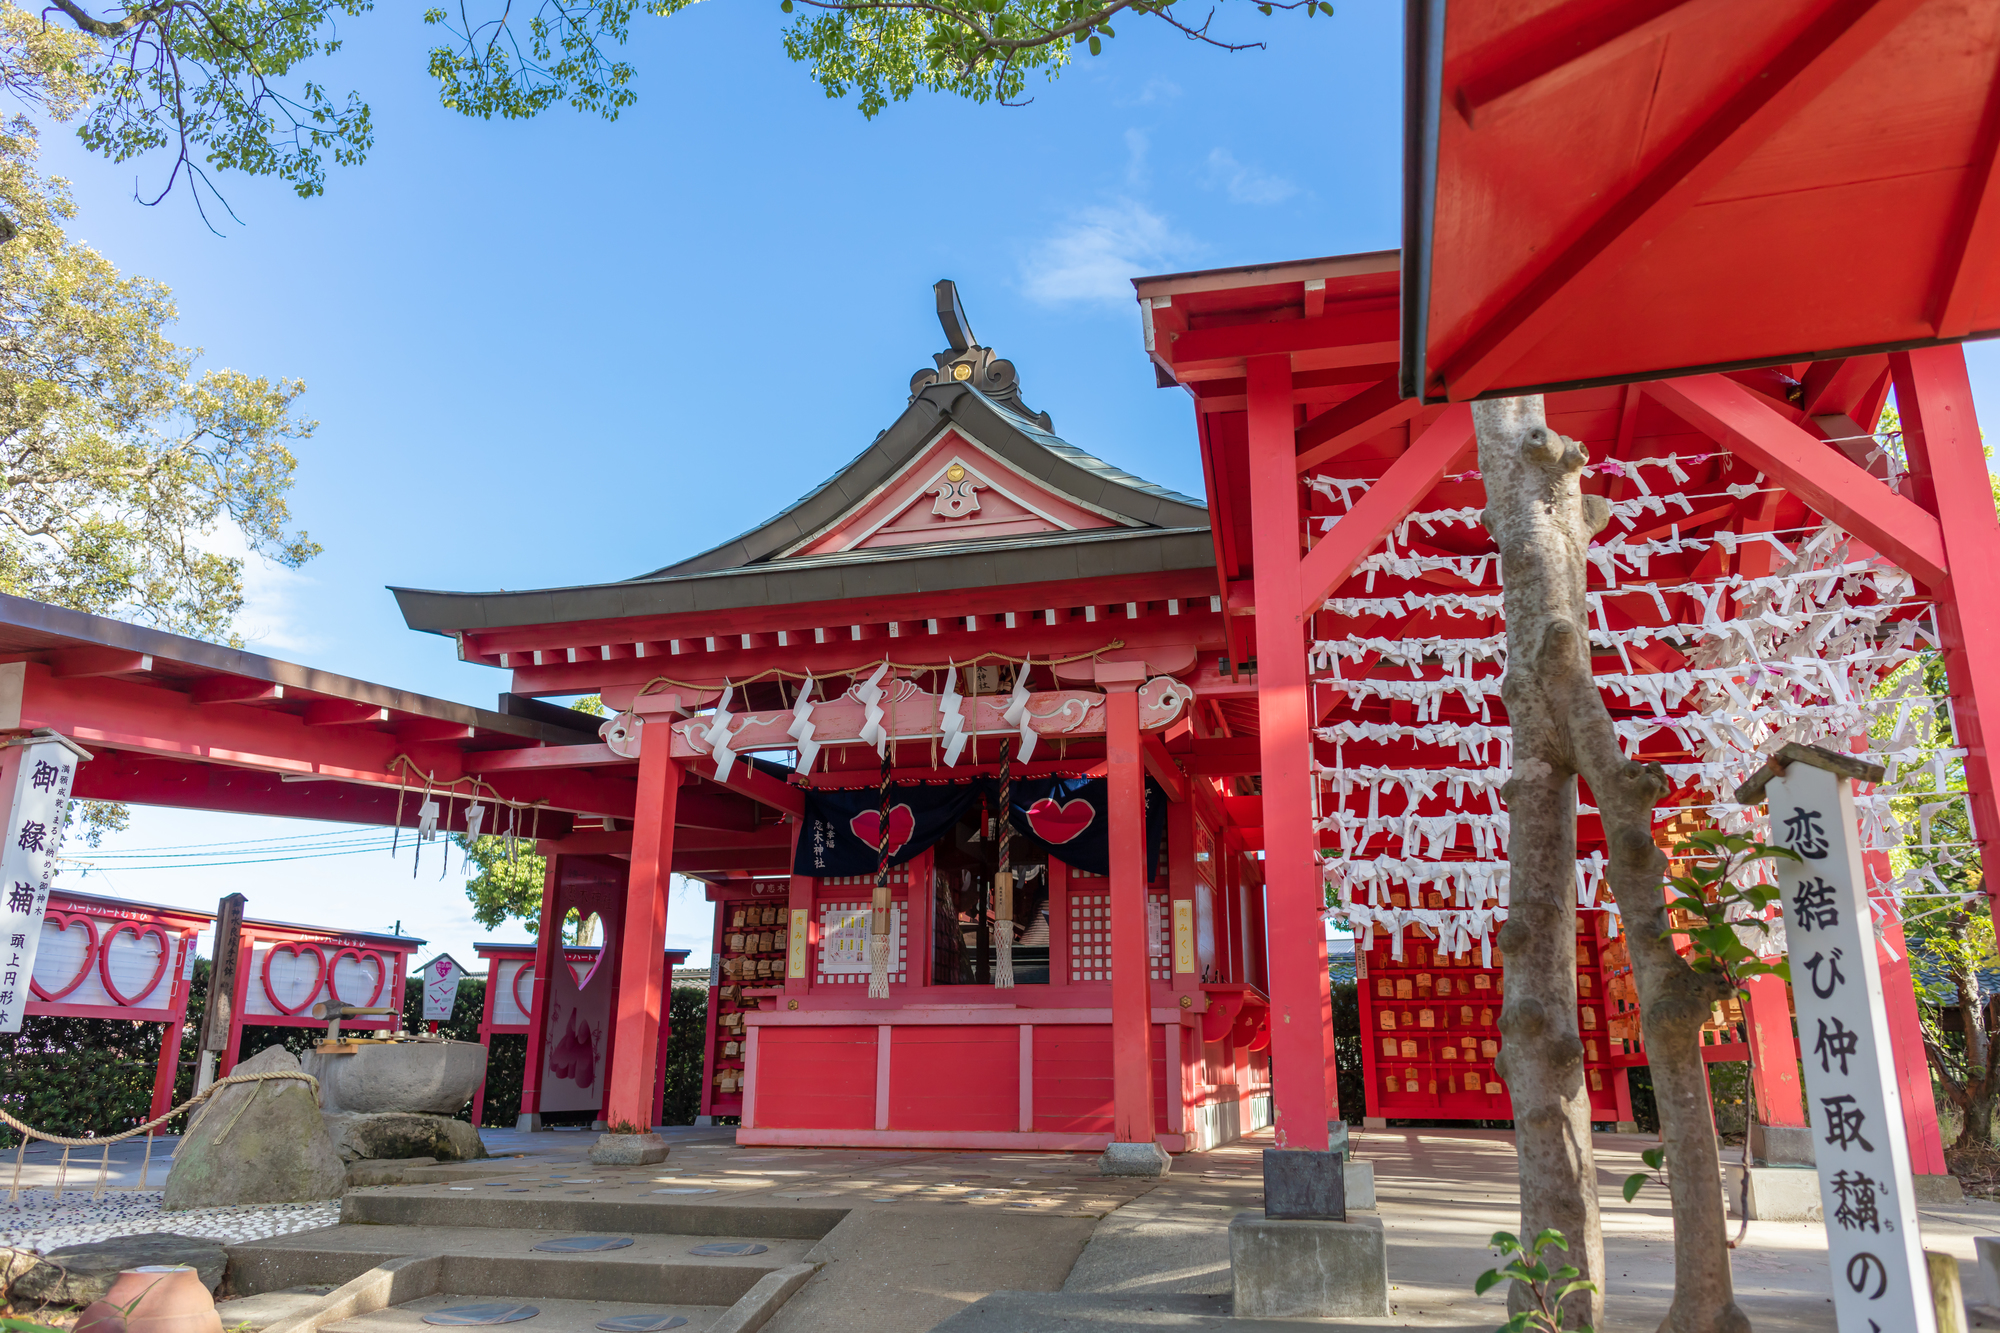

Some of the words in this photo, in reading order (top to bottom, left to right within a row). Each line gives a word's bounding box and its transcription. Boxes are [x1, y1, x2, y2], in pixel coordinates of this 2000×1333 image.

[6, 759, 59, 916] 御縁楠
[766, 883, 790, 893] 恋木
[793, 916, 804, 971] 恋みくじ
[1179, 907, 1190, 965] 恋みくじ
[1784, 806, 1887, 1333] 恋結び仲取黐の
